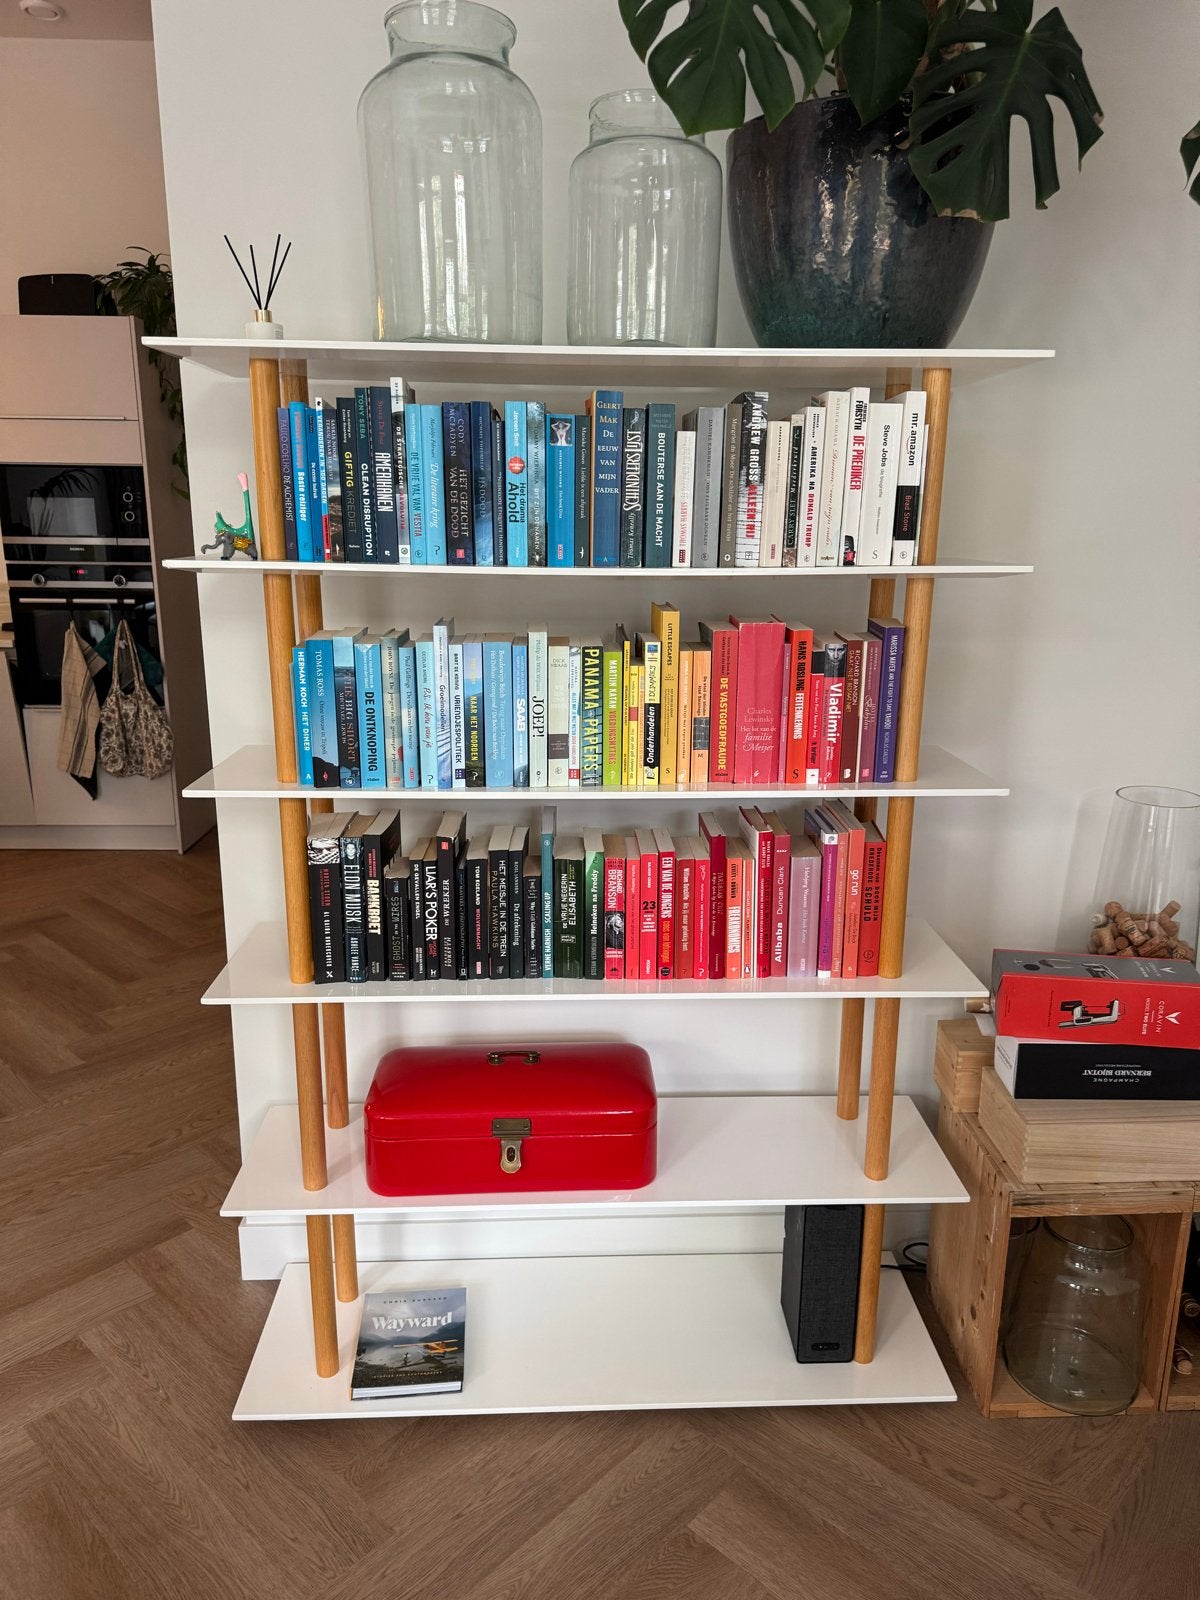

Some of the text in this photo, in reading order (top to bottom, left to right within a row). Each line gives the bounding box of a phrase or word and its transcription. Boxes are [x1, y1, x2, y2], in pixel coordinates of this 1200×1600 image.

[596, 400, 622, 410] GEERT
[854, 400, 864, 430] FORSYTH
[882, 424, 890, 446] Steve
[908, 430, 917, 466] amazon
[282, 444, 290, 473] COELHO
[410, 452, 419, 462] DE
[411, 463, 419, 481] VRIJE
[656, 432, 665, 480] BOUTERSE
[746, 402, 762, 538] ANDREW GROSS ALLEEN HIJ
[809, 446, 817, 478] AMERIKA
[850, 435, 865, 490] DE PREDIKER
[283, 475, 291, 484] DE
[345, 452, 356, 533] GIFTIG KREDIET
[375, 452, 393, 512] AMERIKANEN
[808, 481, 815, 490] NA
[284, 485, 293, 522] ALCHEMIST
[298, 494, 307, 521] reiziger
[361, 463, 373, 556] CLEAN DISRUPTION
[450, 466, 459, 538] VAN DE DOOD
[459, 469, 469, 537] HET GEZICHT
[508, 482, 520, 523] Ahold
[656, 503, 663, 515] DE
[414, 513, 423, 537] VESTIA
[805, 524, 813, 548] TRUMP
[902, 512, 910, 532] Stone
[297, 652, 306, 684] HERMAN
[793, 641, 806, 739] HANS ROSLING FEITENKENNIS
[344, 675, 356, 762] THE BIG SHORT
[516, 698, 525, 732] SAAB
[531, 696, 544, 738] JOEP!
[583, 649, 600, 771] PANAMA PAPERS
[608, 660, 617, 764] MARTIJN KATAN VOEDINGSMYTHES
[718, 678, 728, 770] DE VASTGOEDFRAUDE
[744, 715, 774, 724] Lewinsky
[827, 683, 842, 743] Vladimir
[365, 692, 378, 772] DE ONTKNOPING
[742, 743, 774, 754] Meijer
[744, 733, 772, 743] familie
[607, 869, 616, 908] BRANSON
[850, 870, 859, 880] go
[367, 879, 381, 935] BANKROET
[425, 866, 438, 941] LIAR'S POKER
[544, 892, 551, 900] UP
[643, 901, 656, 910] 23
[863, 886, 872, 922] SCHULD
[343, 864, 361, 972] ELON MUSK ASHLEE VANCE
[500, 922, 506, 932] DE
[1155, 1000, 1165, 1034] CORAVIN
[372, 1312, 452, 1332] Wayward
